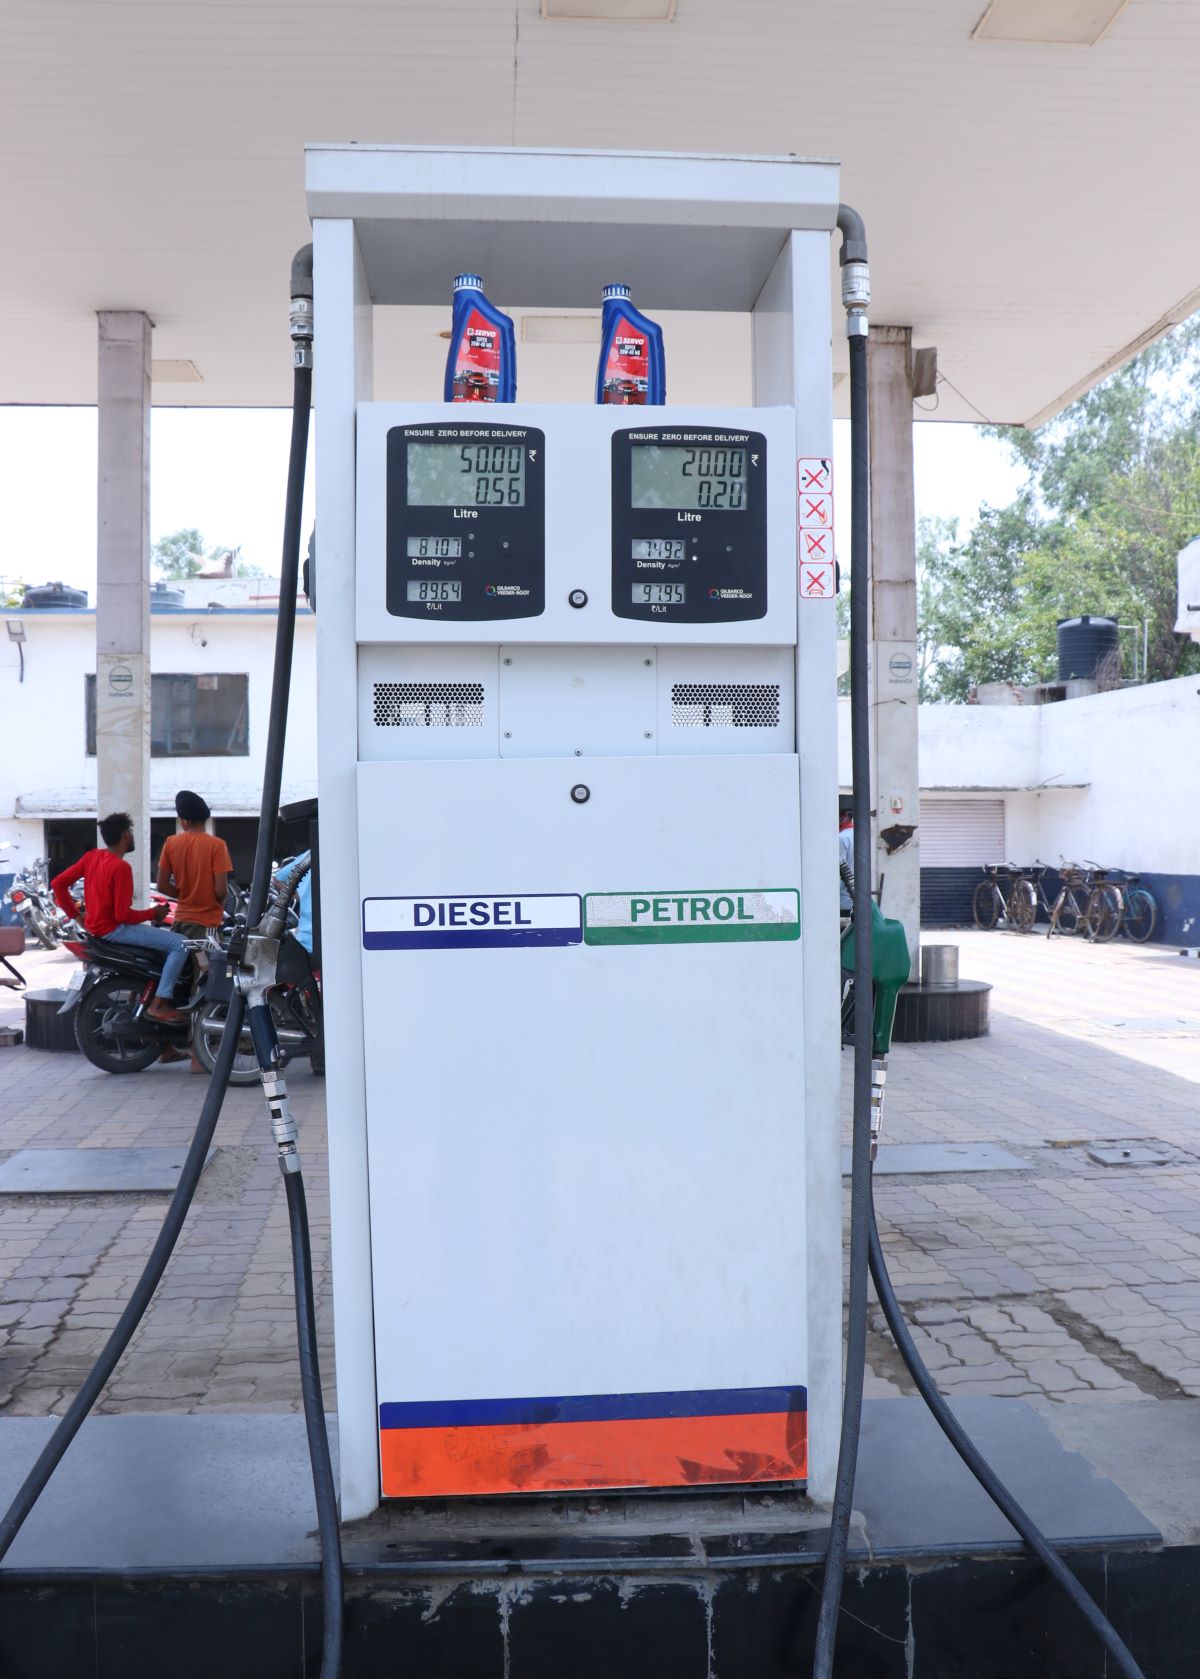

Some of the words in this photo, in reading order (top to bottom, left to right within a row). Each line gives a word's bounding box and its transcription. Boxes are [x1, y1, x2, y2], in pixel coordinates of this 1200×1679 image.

[474, 329, 496, 338] SERVO
[622, 337, 645, 345] SERVO
[404, 429, 434, 437] ENSURE
[491, 430, 527, 438] DELIVERY
[662, 433, 682, 441] ZERO
[714, 434, 749, 442] DELIVERY
[460, 445, 522, 474] 50.00
[682, 450, 743, 477] 20.00
[475, 477, 521, 505] 0.56
[697, 480, 743, 508] 0.20
[453, 508, 478, 518] Litre
[677, 512, 702, 522] Litre
[412, 558, 441, 567] Density
[637, 561, 666, 570] Density
[419, 582, 460, 600] 89.64
[643, 584, 683, 603] 97.95
[413, 901, 532, 927] DIESEL
[630, 896, 754, 923] PETROL
